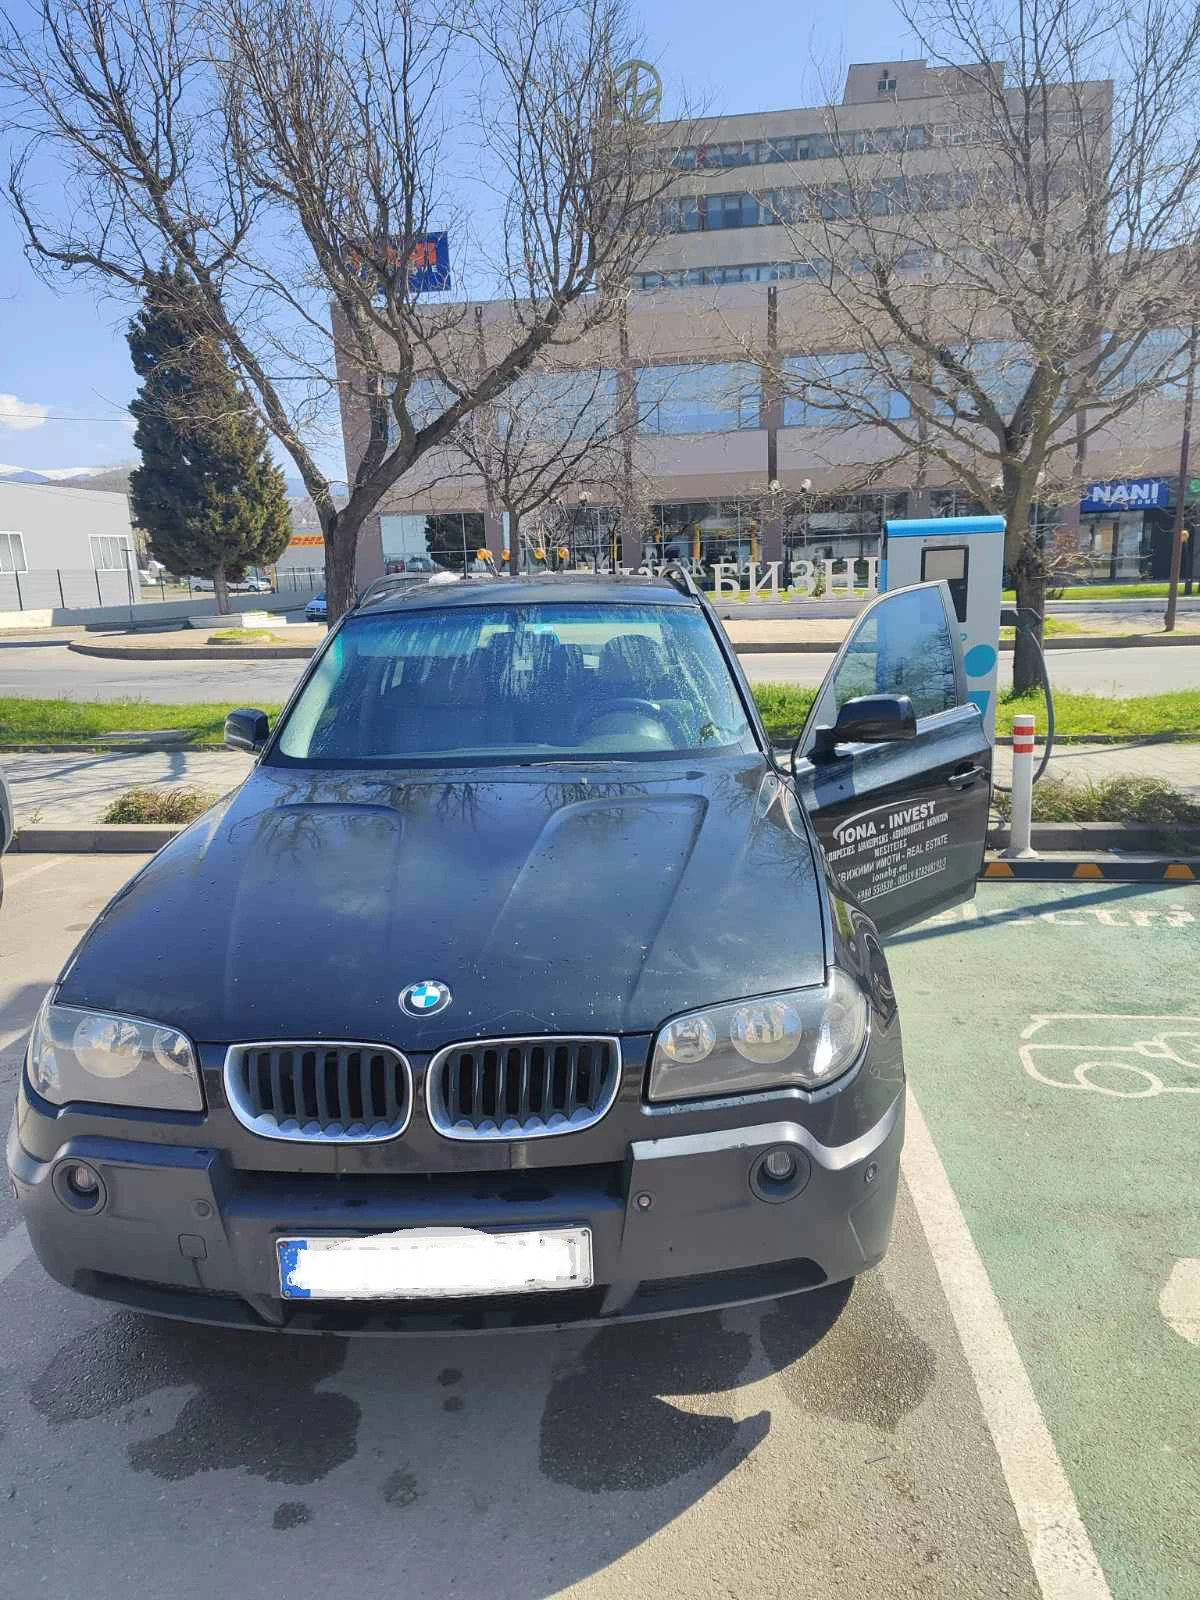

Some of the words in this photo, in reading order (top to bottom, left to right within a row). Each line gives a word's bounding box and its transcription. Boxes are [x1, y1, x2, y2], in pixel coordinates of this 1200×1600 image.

[1092, 482, 1160, 502] NANI
[290, 536, 325, 545] DHL
[840, 822, 877, 846] IONA
[889, 801, 936, 829] INVEST
[906, 843, 925, 860] REAL
[925, 833, 949, 852] ESTATE
